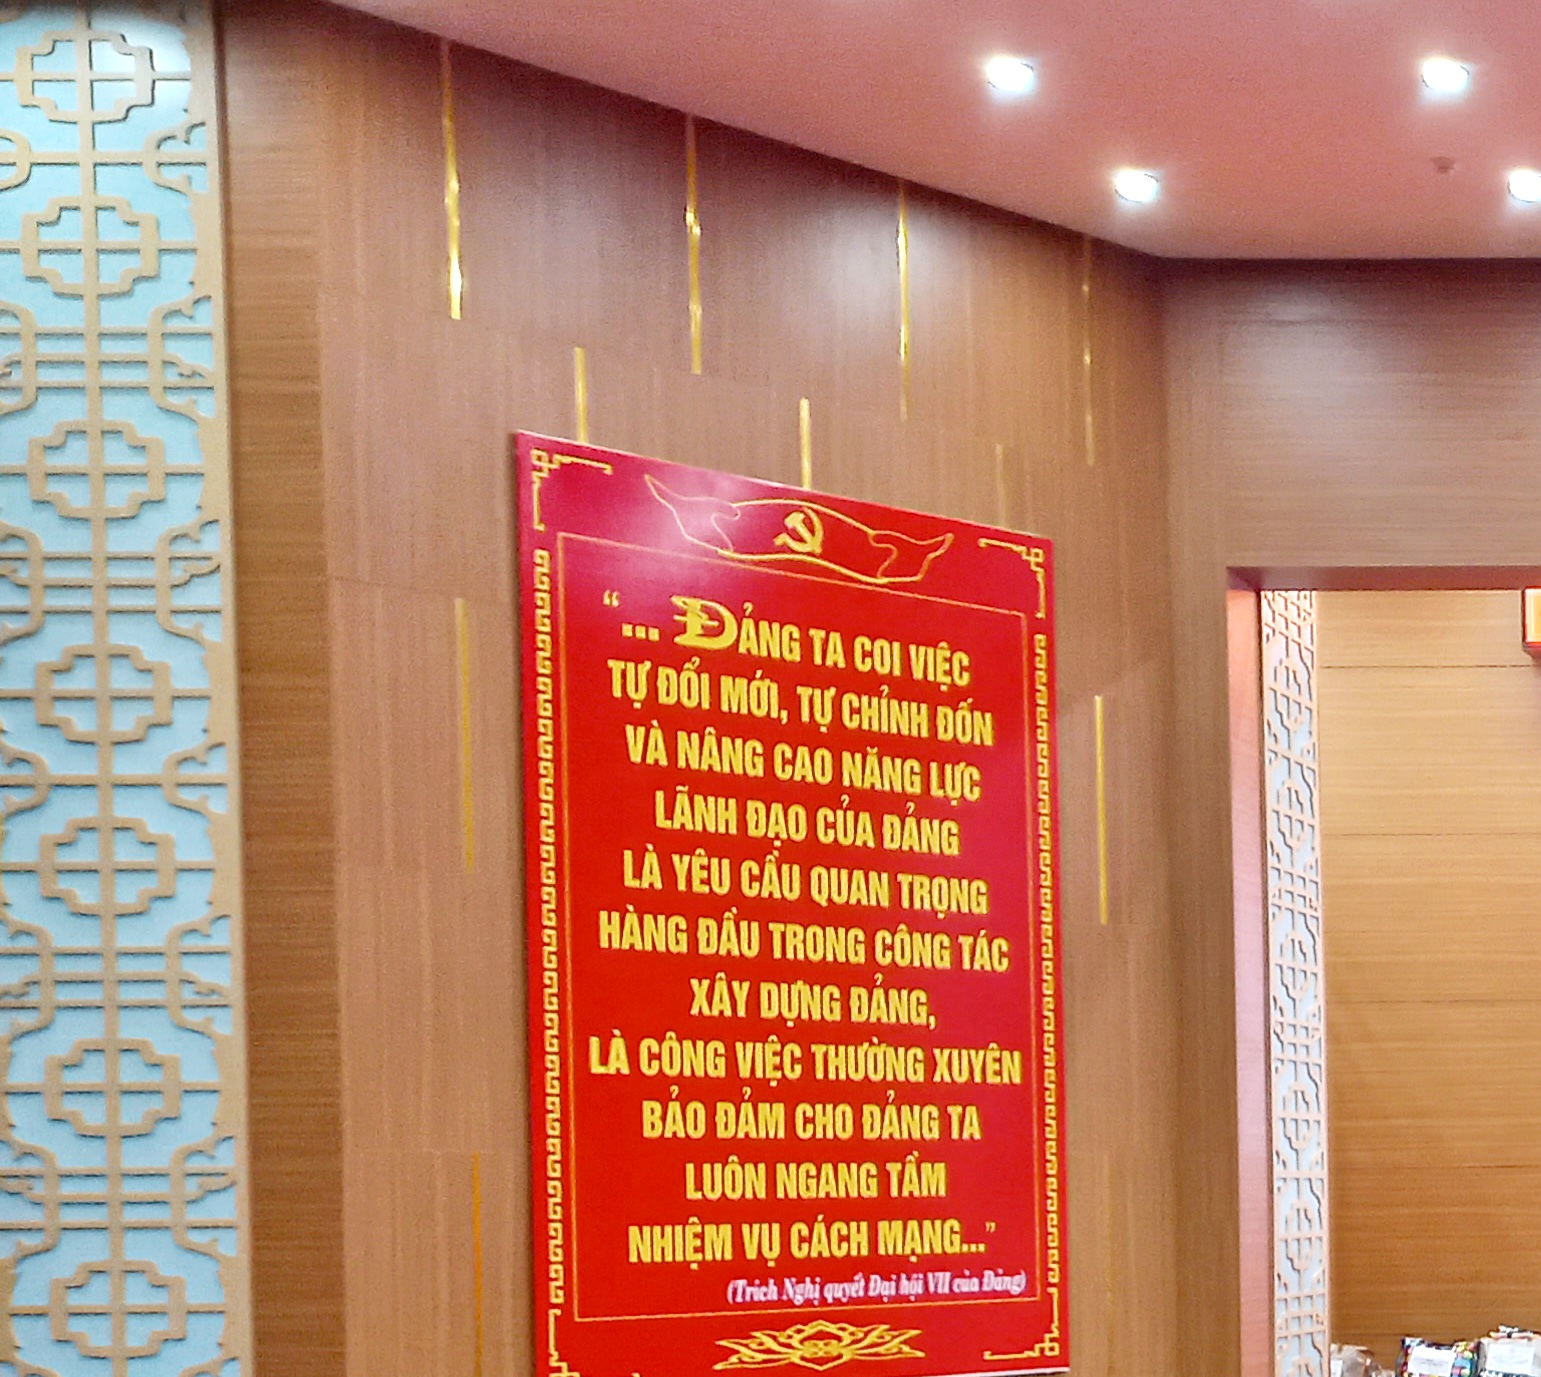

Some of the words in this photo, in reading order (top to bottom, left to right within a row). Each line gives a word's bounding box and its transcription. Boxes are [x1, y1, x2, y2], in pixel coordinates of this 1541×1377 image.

[671, 595, 801, 663] ĐẢNG
[808, 628, 846, 669] TA
[853, 635, 902, 677] COI
[908, 641, 971, 692] VIỆC
[607, 659, 652, 709] TỰ
[656, 656, 711, 710] ĐỔI
[720, 669, 788, 725] MỚI,
[796, 685, 837, 734] TỰ
[841, 684, 929, 738] CHỈNH
[936, 697, 994, 747] ĐỐN
[625, 719, 669, 767] VÀ
[677, 726, 764, 778] NÂNG
[773, 742, 833, 785] CAO
[841, 746, 922, 795] NĂNG
[929, 761, 981, 807] LỰC
[655, 785, 738, 835] LÃNH
[745, 799, 808, 847] ĐẠO
[816, 794, 876, 849] CỦA
[882, 799, 960, 856] ĐẢNG
[623, 843, 663, 890] LÀ
[671, 847, 731, 895] YÊU
[740, 849, 801, 901] CẦU
[810, 865, 890, 908] QUAN
[896, 873, 990, 920] TRỌNG
[599, 904, 688, 954] HÀNG
[696, 906, 760, 958] ĐẦU
[768, 922, 866, 965] TRONG
[874, 923, 952, 970] CÔNG
[958, 929, 1009, 973] TÁC
[690, 971, 751, 1018] XÂY
[759, 980, 842, 1028] DỰNG
[849, 972, 936, 1029] ĐẢNG,
[589, 1029, 630, 1075] LÀ
[639, 1031, 726, 1078] CÔNG
[735, 1034, 802, 1087] VIỆC
[810, 1036, 925, 1083] THƯỜNG
[933, 1042, 1022, 1085] XUYÊN
[642, 1085, 706, 1139] BẢO
[715, 1086, 785, 1139] ĐẢM
[795, 1102, 854, 1140] CHO
[861, 1089, 940, 1141] ĐẢNG
[946, 1104, 982, 1140] TA
[685, 1154, 767, 1200] LUÔN
[776, 1161, 879, 1199] NGANG
[885, 1150, 947, 1198] TẦM
[628, 1216, 733, 1270] NHIỆM
[741, 1222, 781, 1268] VỤ
[790, 1214, 869, 1259] CÁCH
